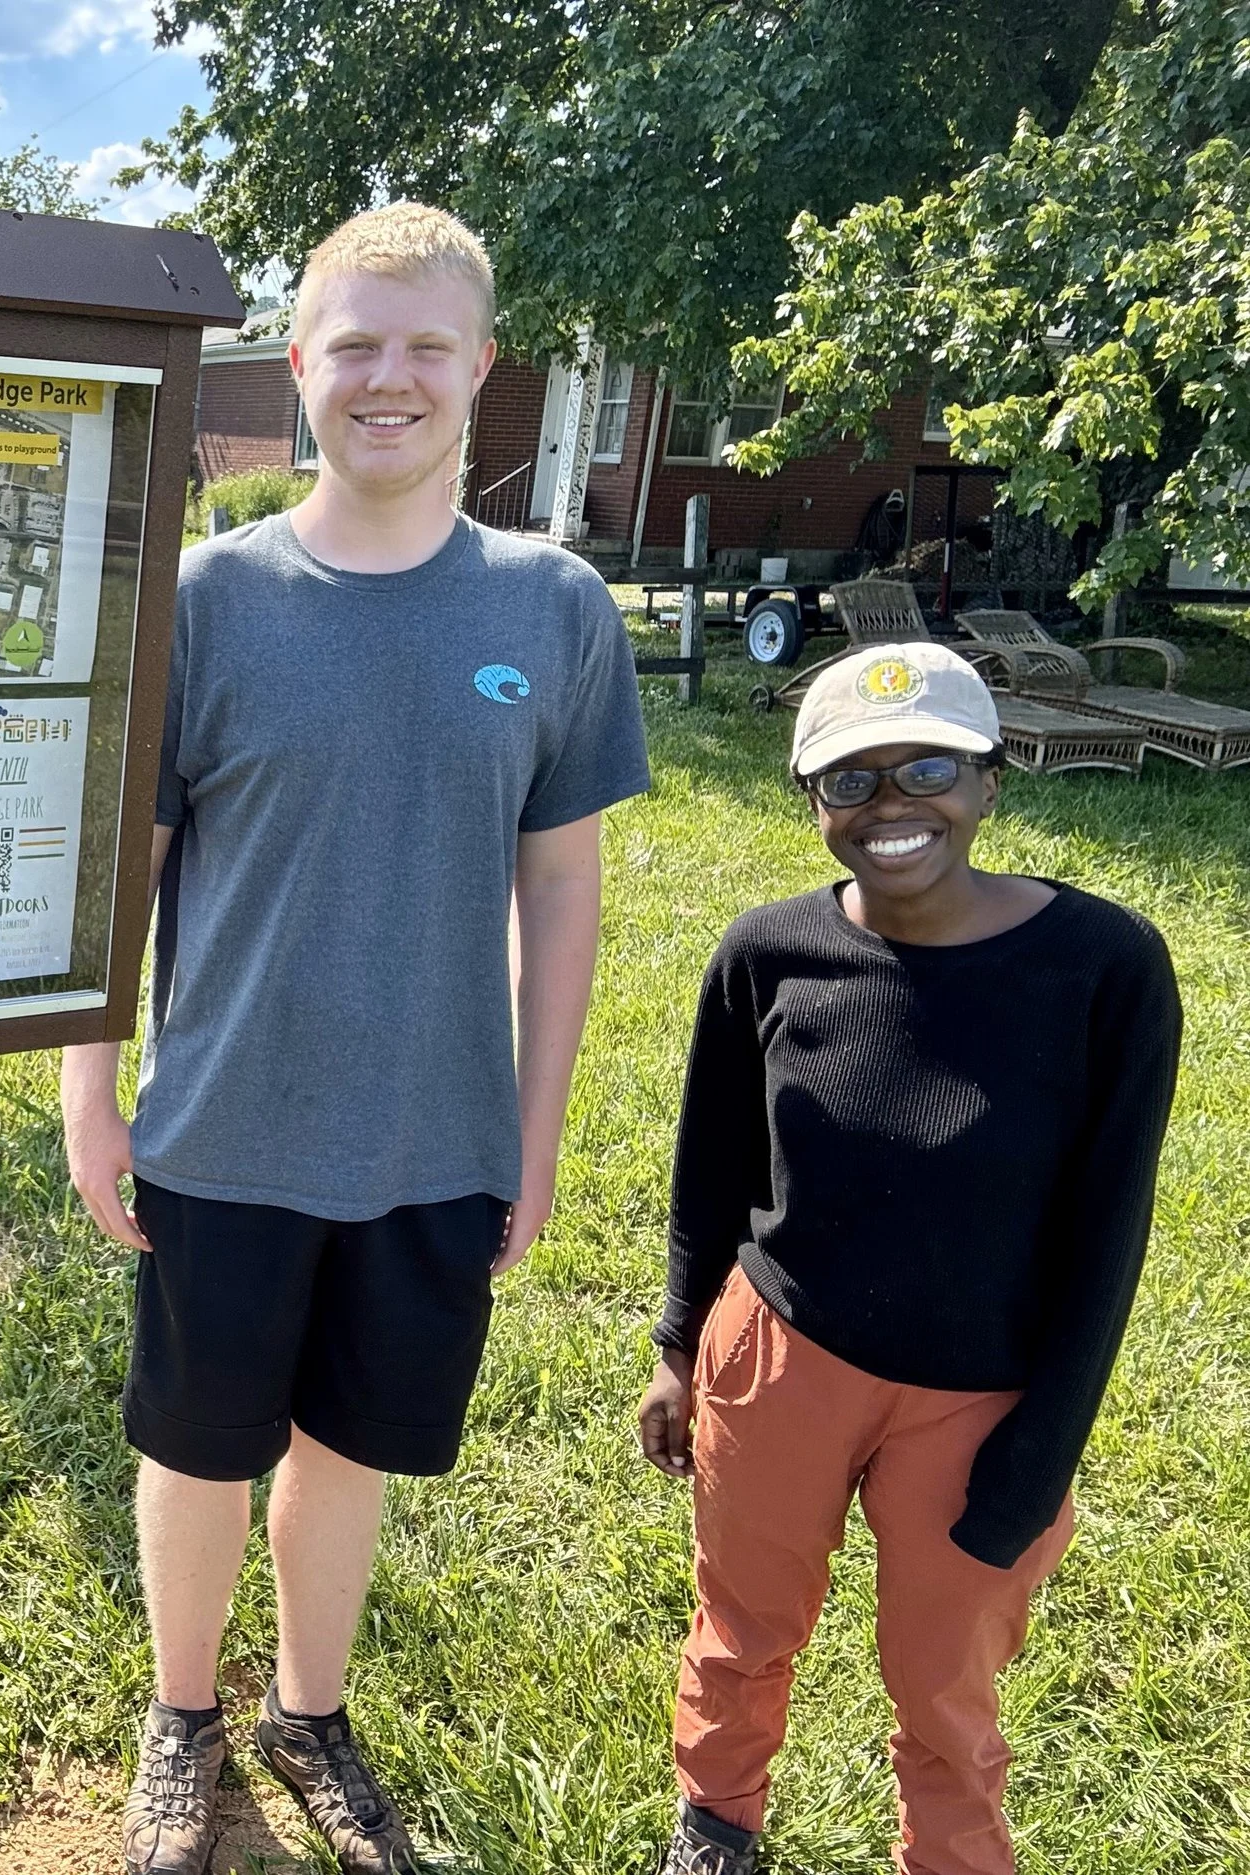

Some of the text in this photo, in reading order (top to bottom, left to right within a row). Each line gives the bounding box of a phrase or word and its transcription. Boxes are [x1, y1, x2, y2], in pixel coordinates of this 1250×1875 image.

[40, 381, 88, 406] Park
[14, 444, 57, 456] playground
[15, 796, 44, 819] PARK
